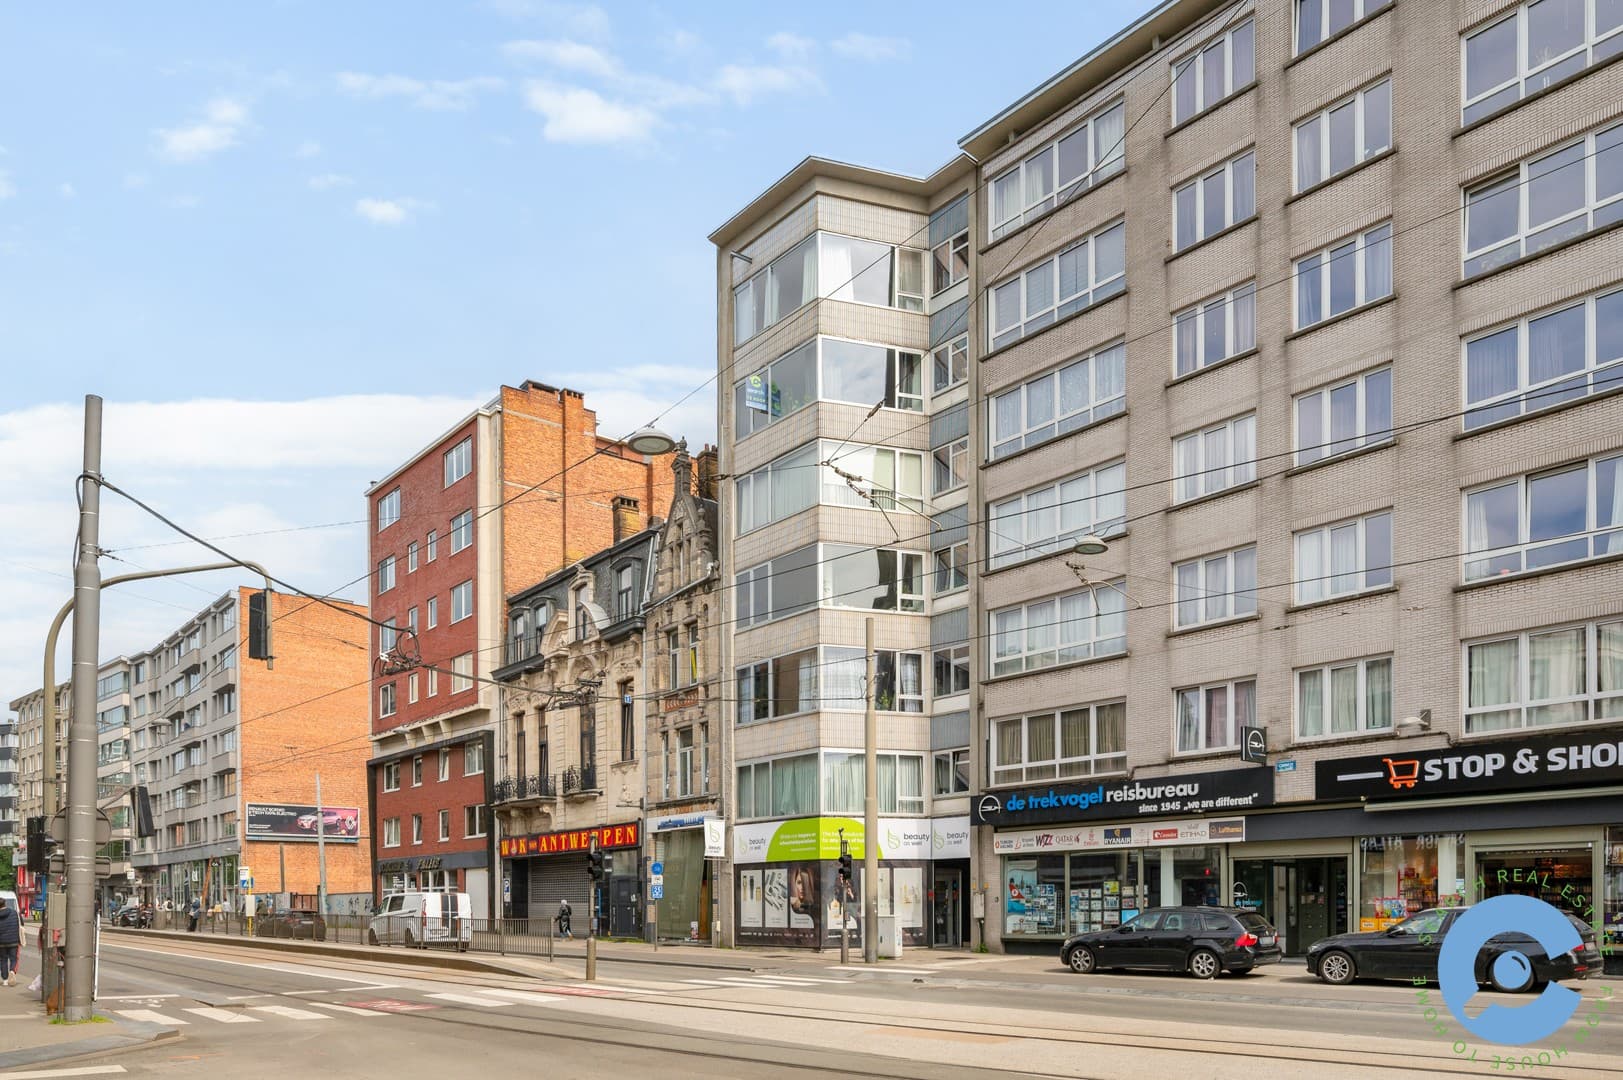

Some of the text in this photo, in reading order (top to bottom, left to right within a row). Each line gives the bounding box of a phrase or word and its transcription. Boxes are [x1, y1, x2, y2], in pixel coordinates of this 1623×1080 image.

[1424, 753, 1505, 782] STOP
[1513, 748, 1540, 774] &
[1006, 794, 1026, 811] de
[1106, 782, 1199, 803] reisbureau
[1138, 803, 1158, 813] since
[1160, 801, 1181, 812] 1945
[1201, 799, 1214, 808] are
[749, 837, 766, 846] beauty
[903, 832, 930, 842] beauty
[946, 831, 969, 840] beauty
[1035, 833, 1054, 847] WIZZ
[1104, 837, 1131, 845] RYANAIR
